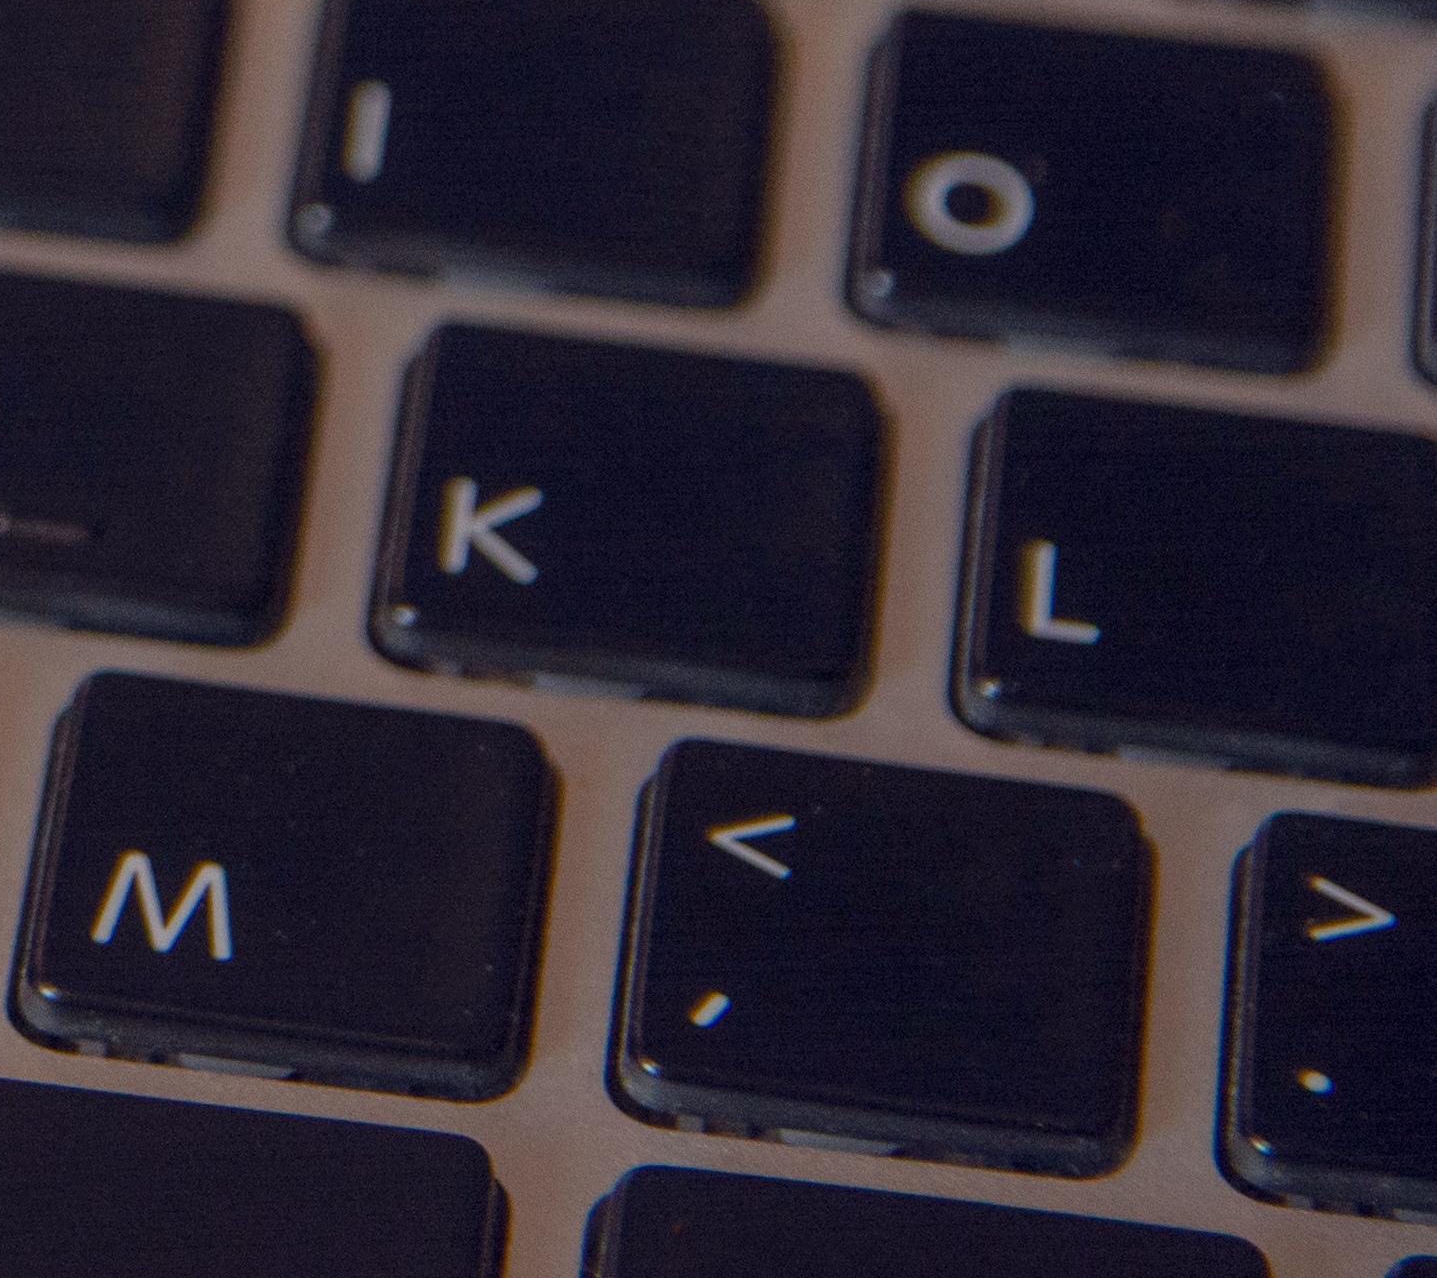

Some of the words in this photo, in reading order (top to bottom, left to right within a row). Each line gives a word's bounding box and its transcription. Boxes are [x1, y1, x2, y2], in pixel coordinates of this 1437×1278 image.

[344, 81, 392, 185] I
[904, 150, 1037, 255] O
[439, 476, 543, 586] K
[1022, 540, 1101, 645] L
[91, 849, 236, 962] M
